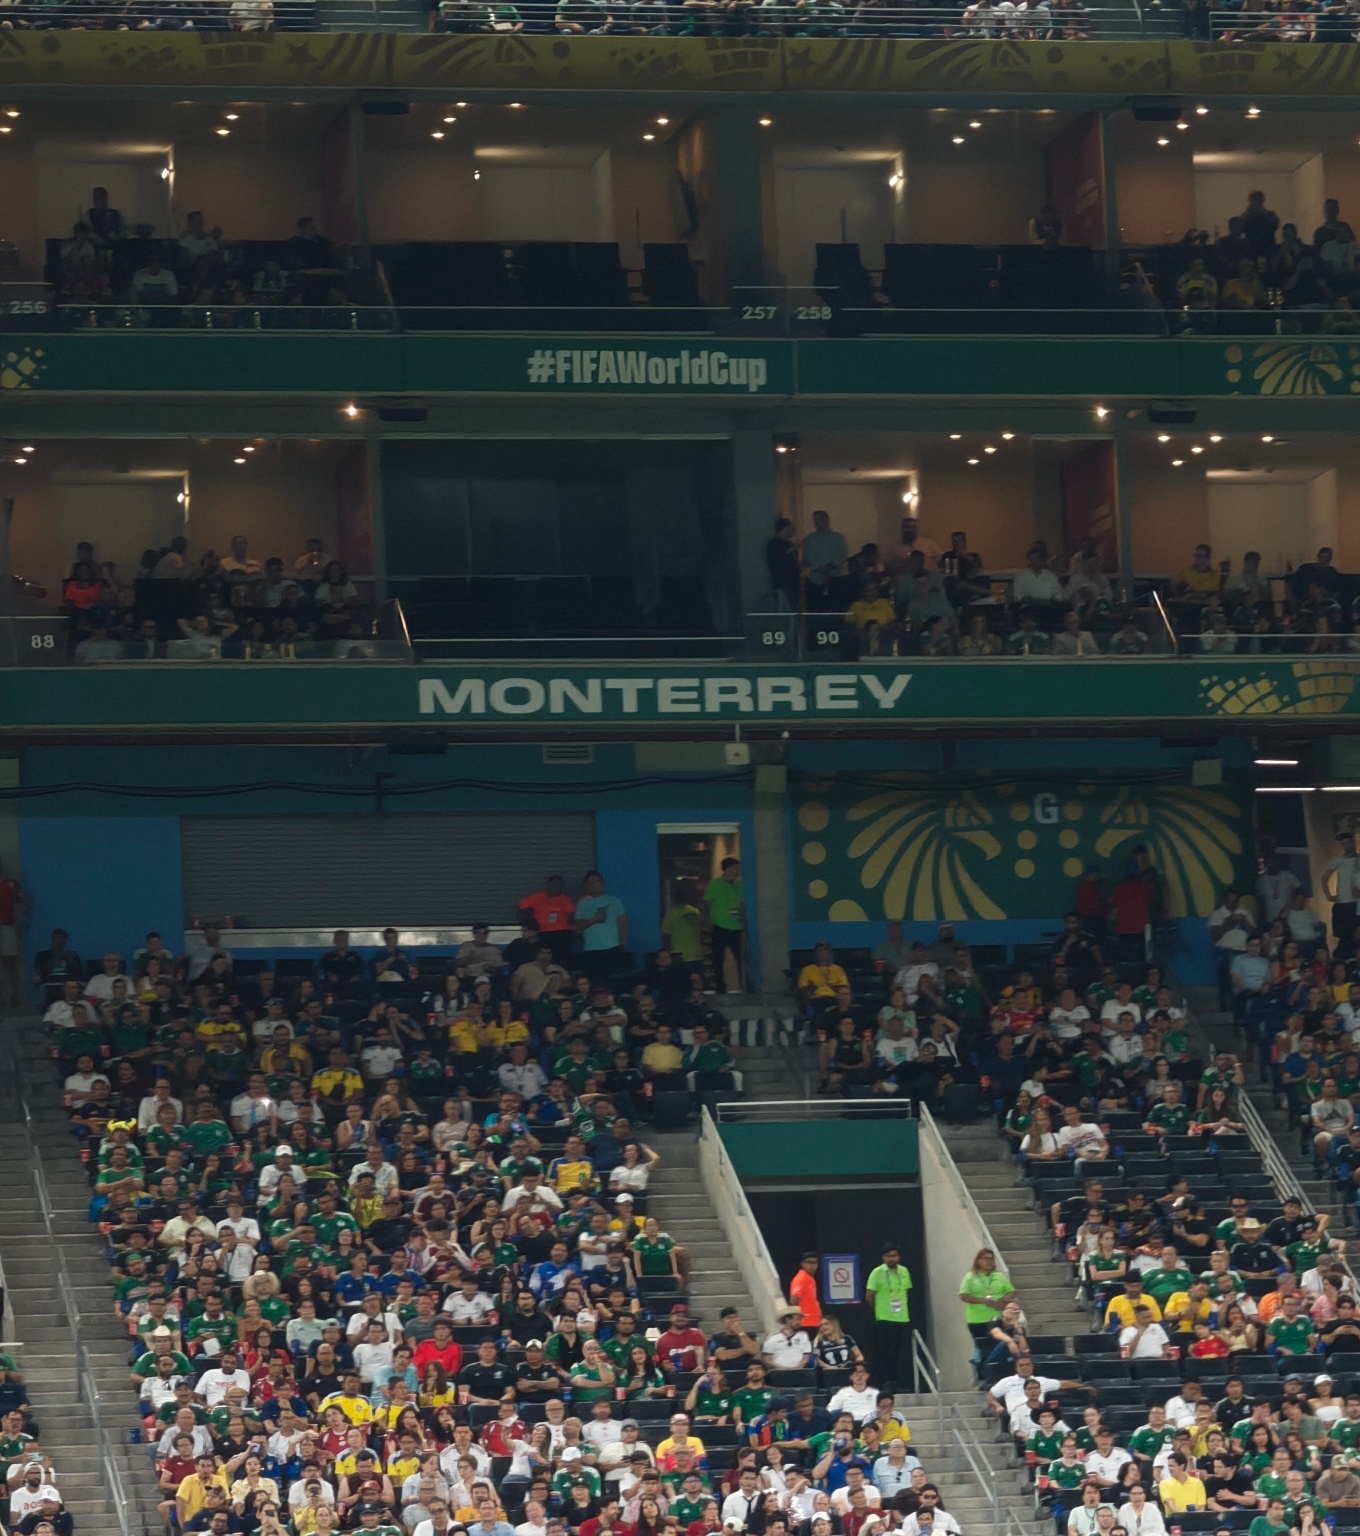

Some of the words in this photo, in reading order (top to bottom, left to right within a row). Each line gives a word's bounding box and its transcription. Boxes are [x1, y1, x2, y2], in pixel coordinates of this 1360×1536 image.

[9, 300, 47, 315] 256
[741, 305, 777, 320] 257
[796, 305, 833, 320] 258
[527, 349, 767, 391] #FIFAWorldCup
[31, 634, 55, 649] 88
[762, 631, 786, 645] 89
[816, 630, 840, 645] 90
[418, 674, 913, 714] MONTERREY
[1034, 792, 1059, 825] G
